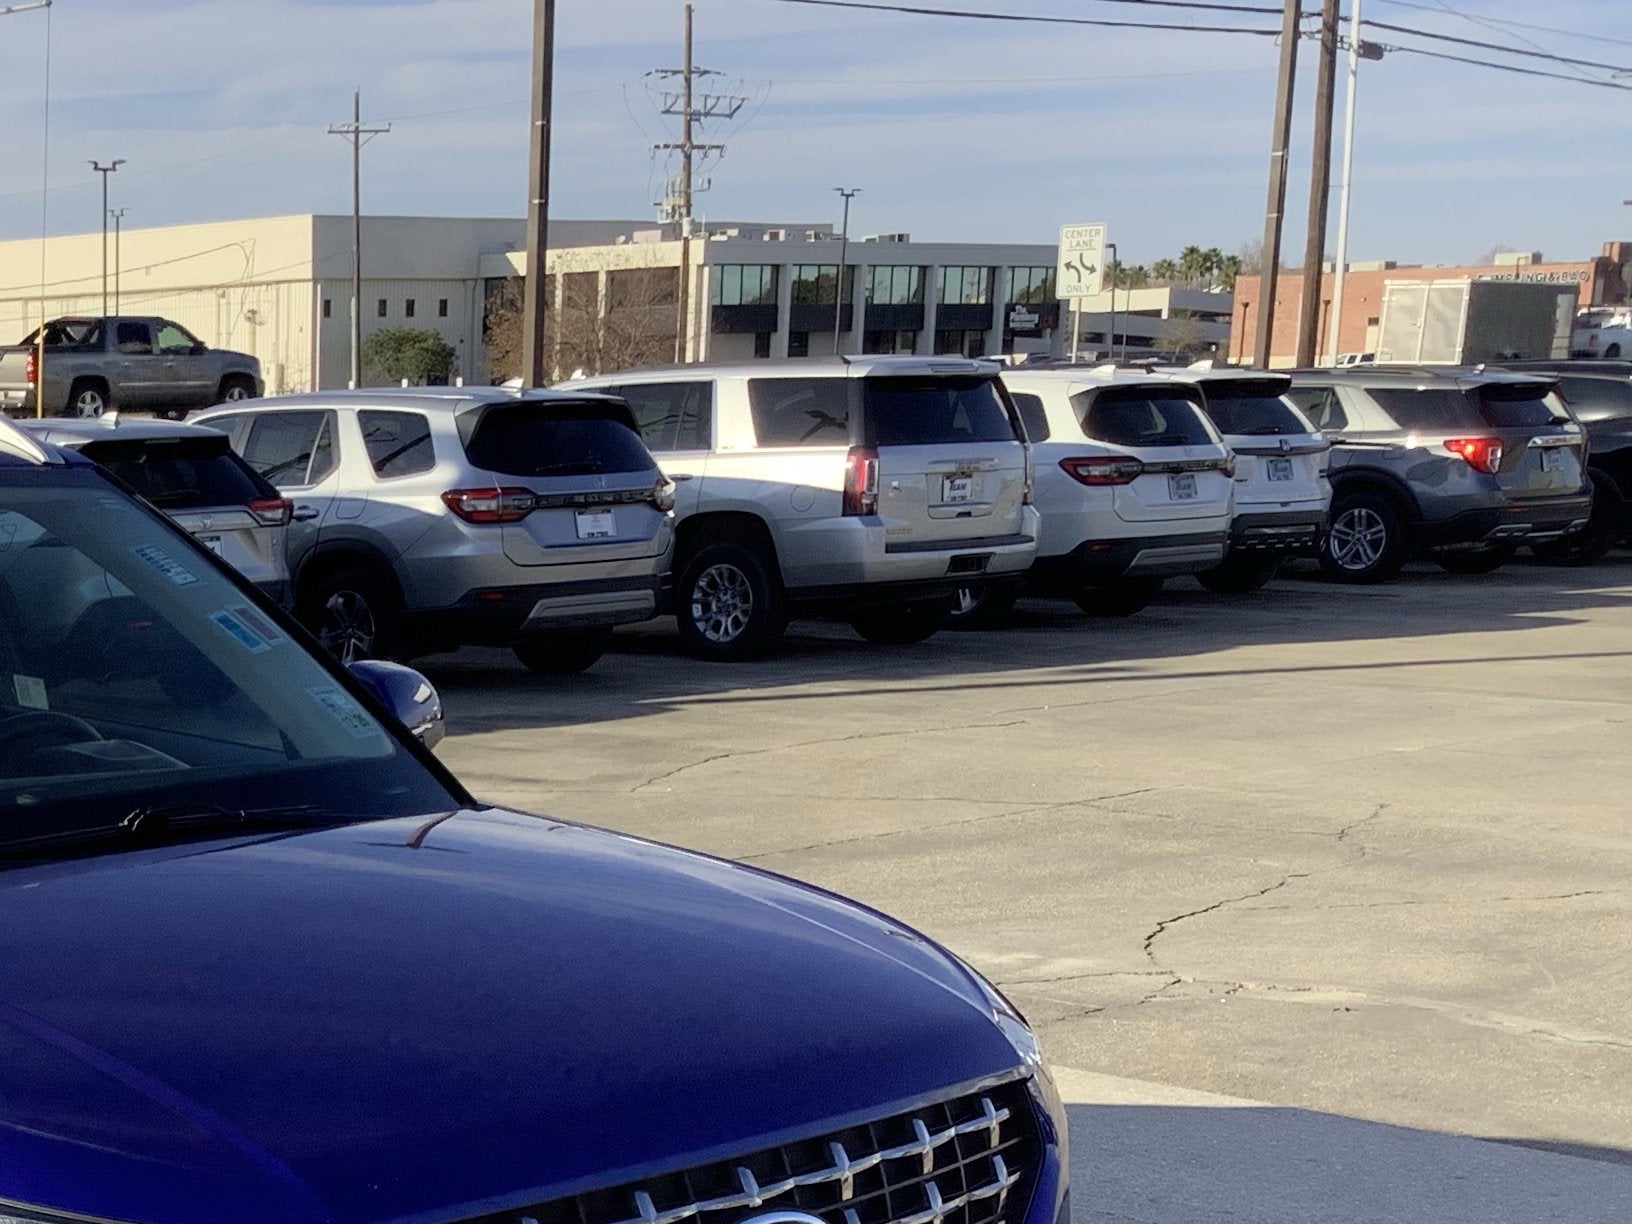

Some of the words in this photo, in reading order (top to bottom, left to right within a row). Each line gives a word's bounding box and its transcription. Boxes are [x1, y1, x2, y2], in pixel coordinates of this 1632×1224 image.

[1064, 229, 1100, 239] CENTER
[1069, 240, 1094, 249] LANE
[1065, 284, 1092, 293] ONLY
